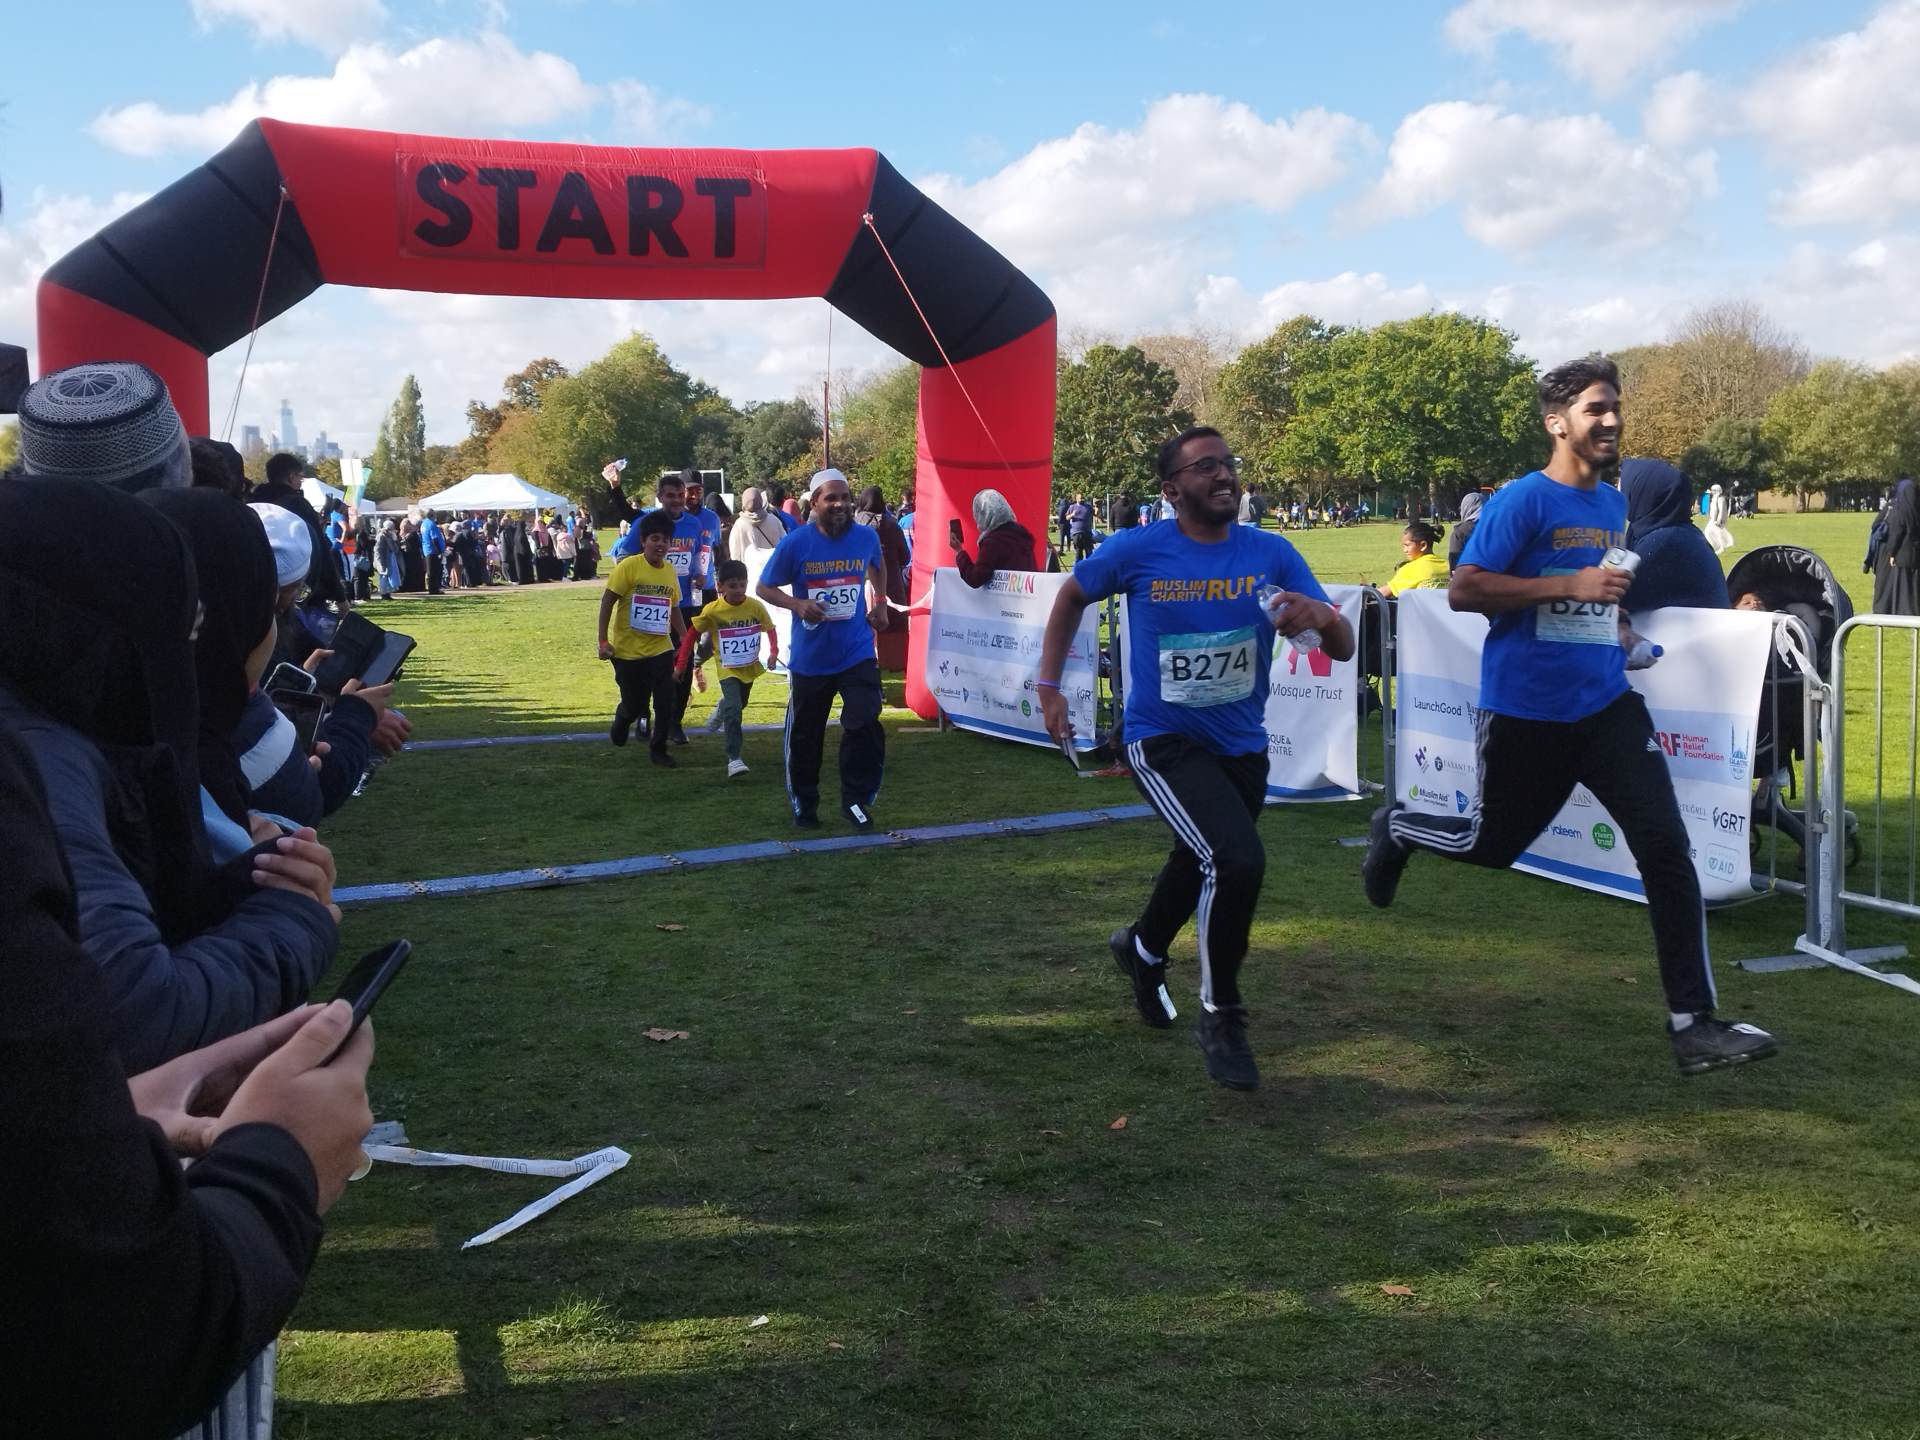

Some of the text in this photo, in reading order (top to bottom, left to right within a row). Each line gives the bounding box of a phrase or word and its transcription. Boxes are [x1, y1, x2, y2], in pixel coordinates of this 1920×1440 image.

[413, 162, 752, 258] START
[834, 559, 865, 572] RUN
[1008, 573, 1034, 594] RUN
[1152, 578, 1206, 592] MUSLIM
[1151, 590, 1204, 602] CHARITY
[1171, 646, 1250, 682] B274
[1270, 682, 1312, 700] Mosque
[1314, 685, 1343, 701] Trust
[1414, 697, 1462, 717] LaunchGood
[1682, 734, 1709, 744] Human
[1269, 745, 1293, 756] ENTRE
[1683, 742, 1705, 752] Relief
[1684, 750, 1724, 761] Foundation
[1720, 811, 1746, 833] GRT
[1718, 860, 1735, 874] AID
